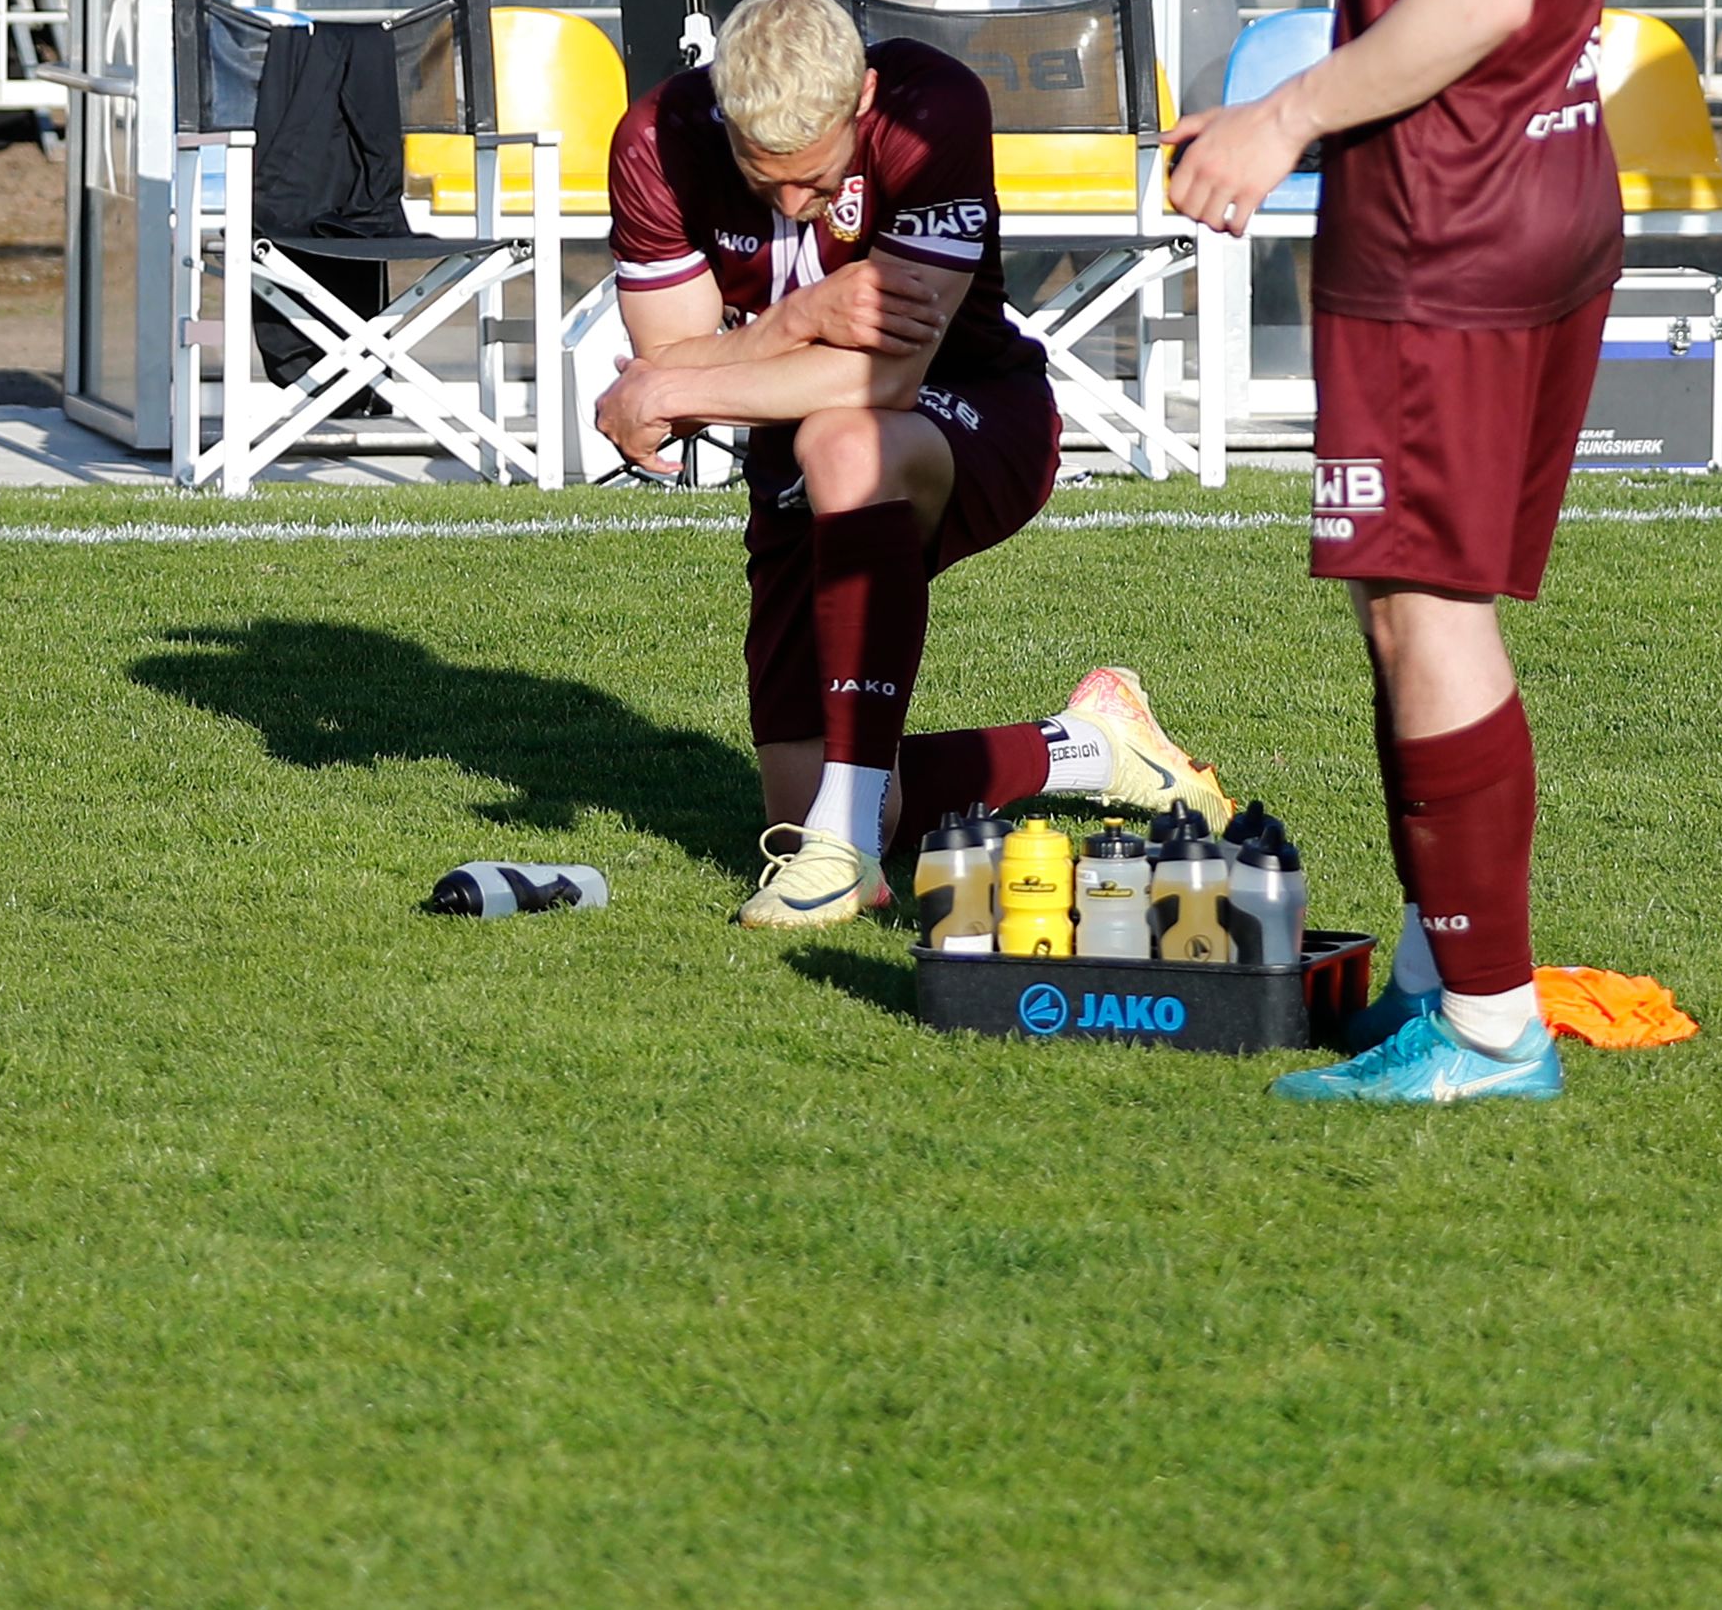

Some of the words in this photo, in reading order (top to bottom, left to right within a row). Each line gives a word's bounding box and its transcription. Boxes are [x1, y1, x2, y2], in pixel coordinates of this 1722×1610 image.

[892, 204, 988, 237] DWB
[1575, 438, 1664, 456] GUNGSWERK
[1314, 465, 1386, 505] WB
[1313, 517, 1355, 540] AKO
[829, 678, 896, 696] JAKO
[1050, 740, 1101, 763] EDESIGN
[1421, 914, 1471, 931] AKO
[1077, 993, 1187, 1032] JAKO
